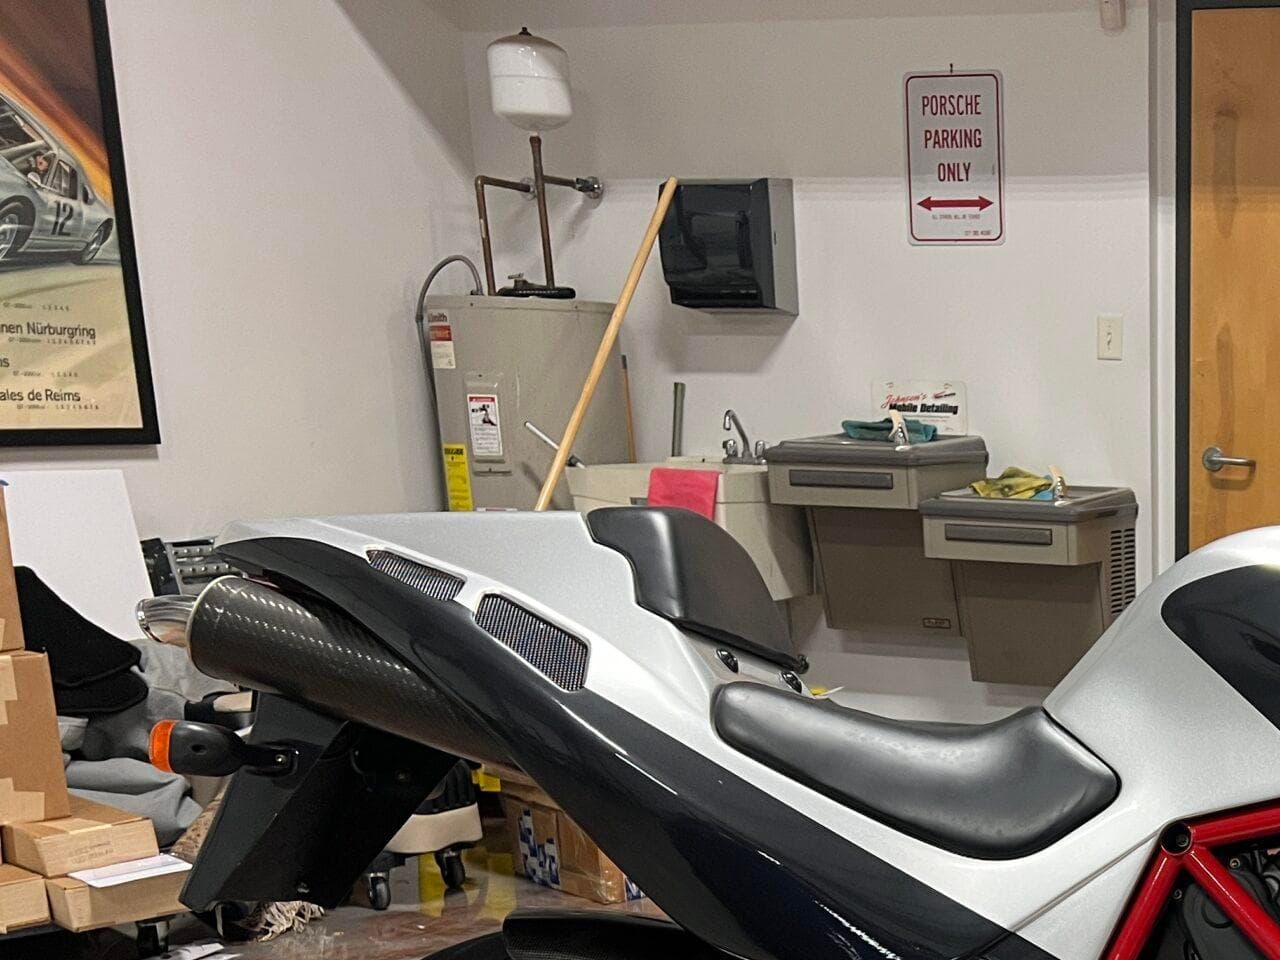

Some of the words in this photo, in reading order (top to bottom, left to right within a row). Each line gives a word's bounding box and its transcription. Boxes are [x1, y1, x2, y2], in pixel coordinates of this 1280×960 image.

[921, 94, 982, 117] PORSCHE
[924, 128, 982, 149] PARKING
[937, 162, 972, 182] ONLY
[50, 200, 74, 237] 12
[26, 320, 96, 340] Nürburgring
[27, 388, 42, 401] de
[44, 388, 81, 402] Reims
[888, 403, 918, 413] Mobile
[920, 404, 959, 415] Detailing
